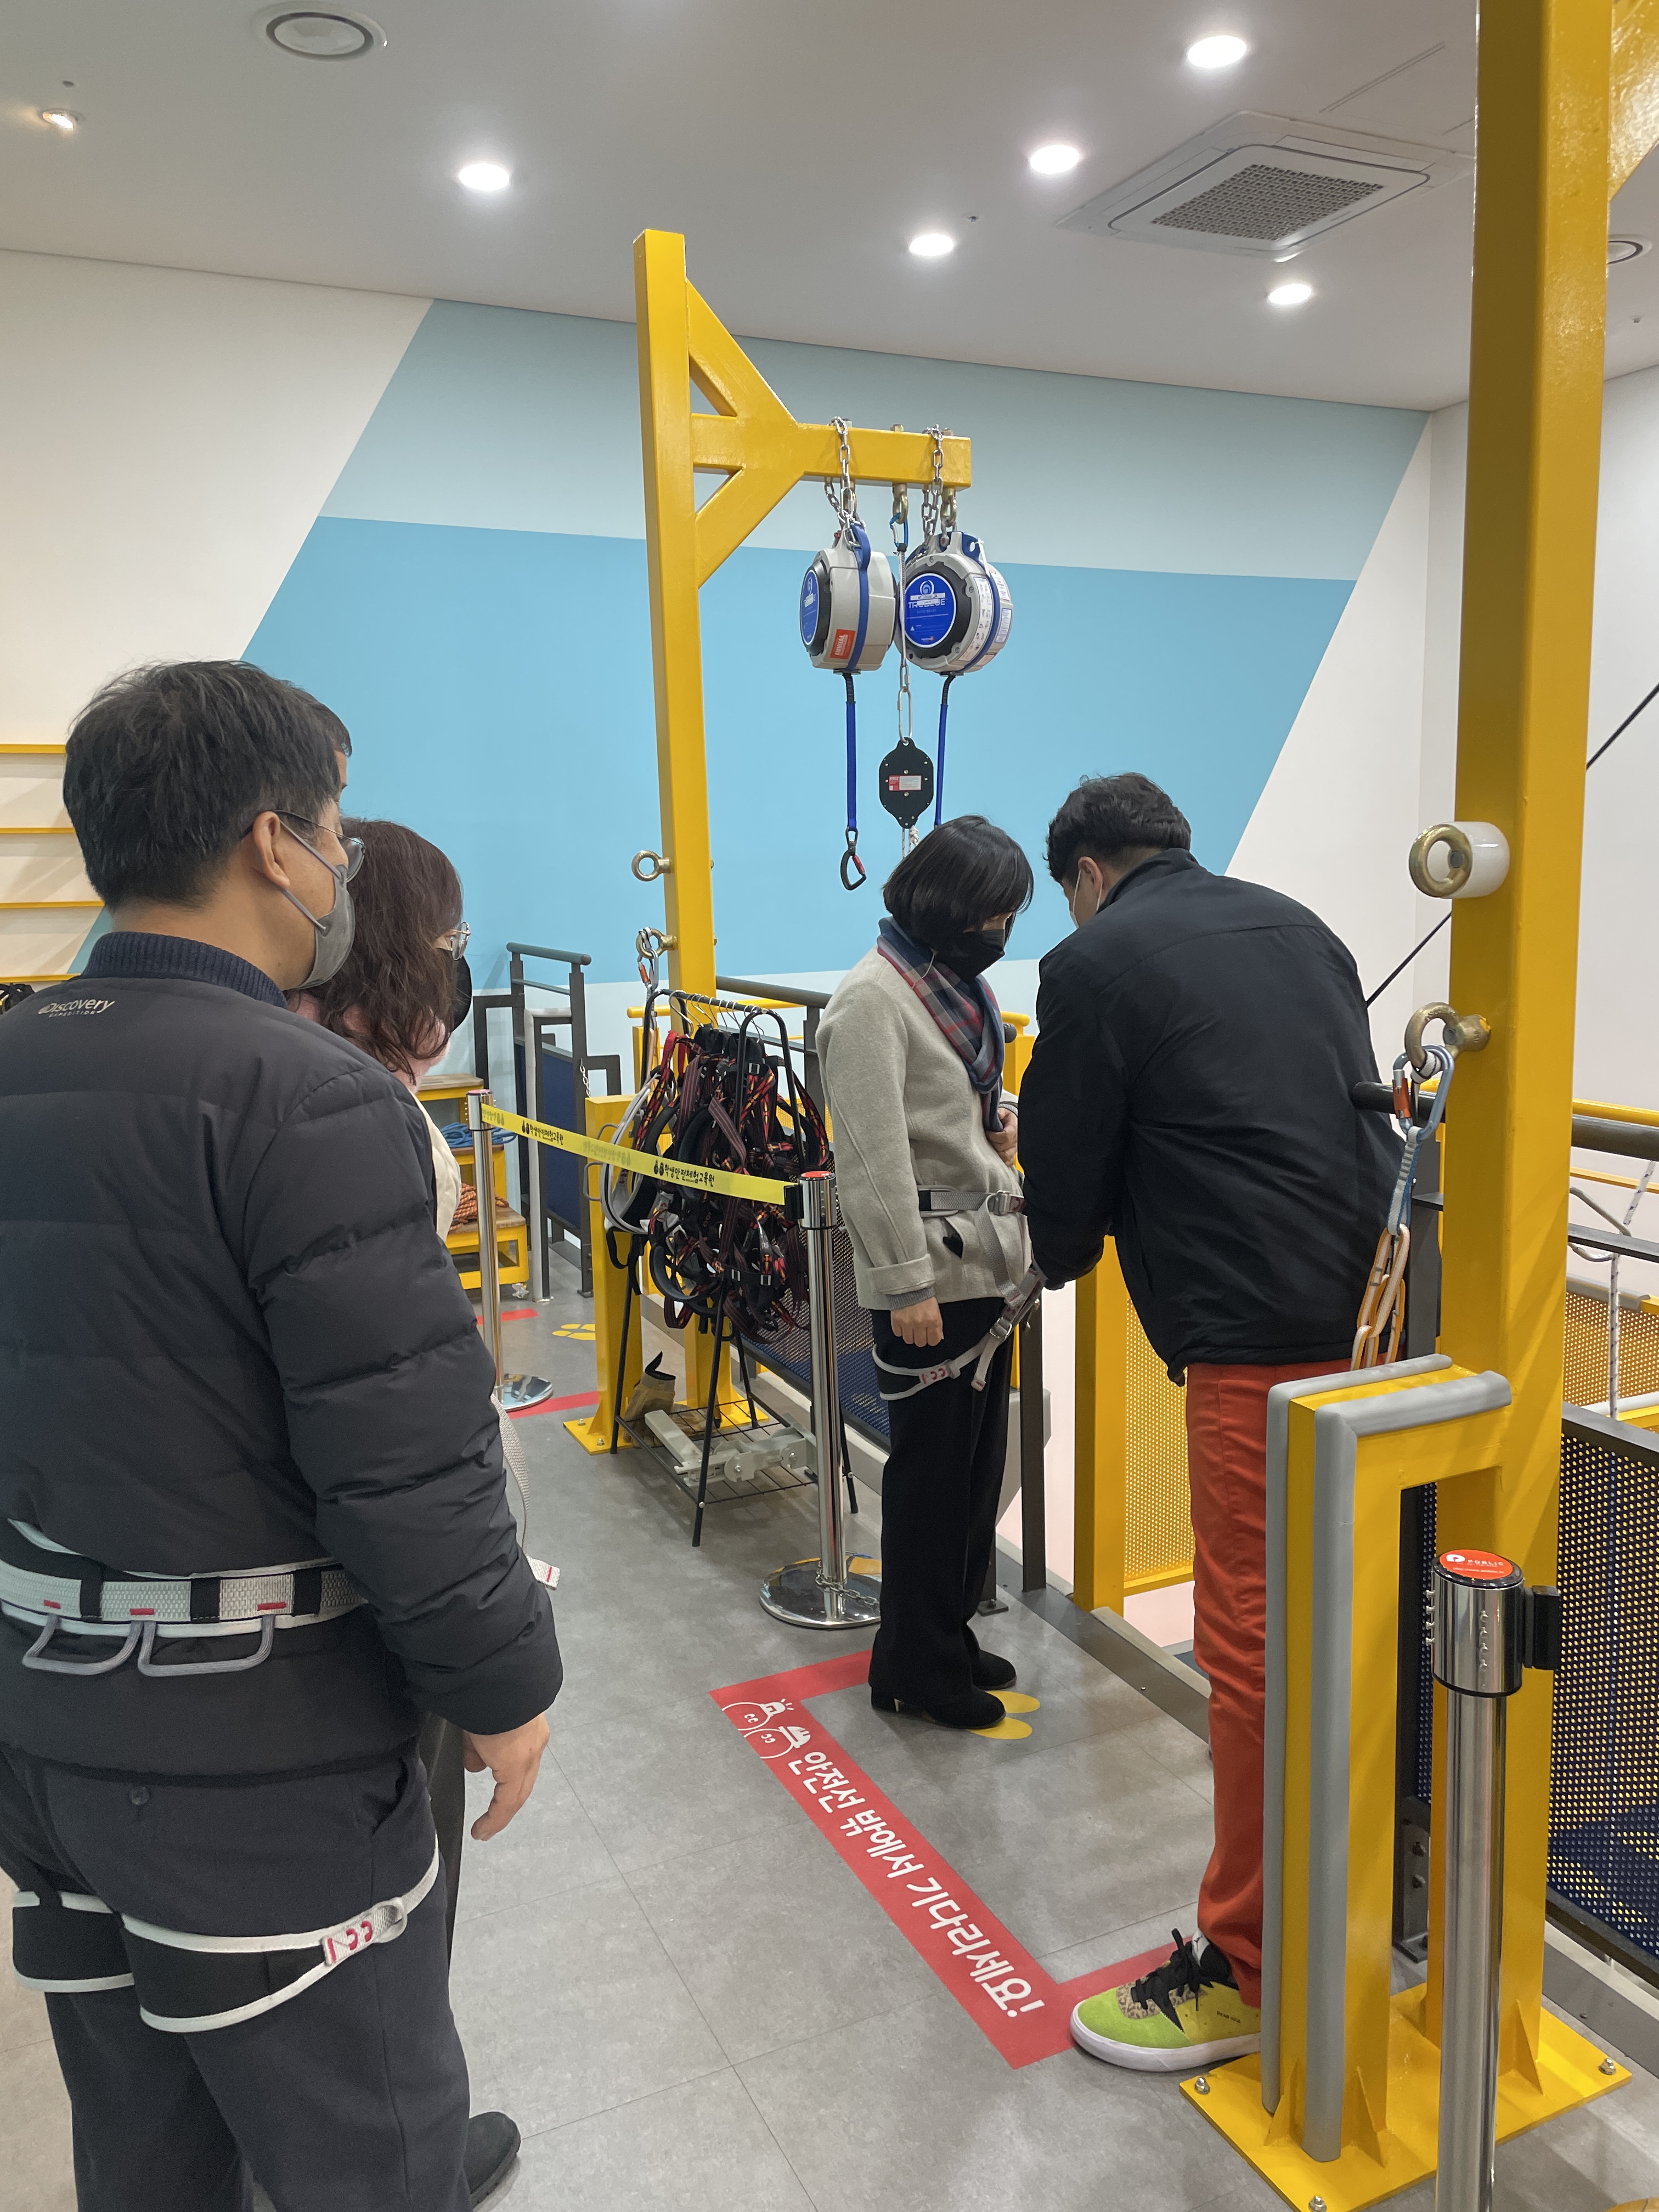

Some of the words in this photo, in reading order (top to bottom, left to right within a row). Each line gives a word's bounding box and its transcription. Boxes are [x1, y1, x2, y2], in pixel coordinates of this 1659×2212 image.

[834, 634, 846, 655] ANNUAL
[530, 1124, 564, 1145] 학생안전체험교육원
[664, 1164, 715, 1187] 학생안전체험교육원
[788, 1752, 866, 1813] 안전선
[839, 1809, 924, 1878] 밖에서
[906, 1877, 1045, 2017] 기다리세요!
